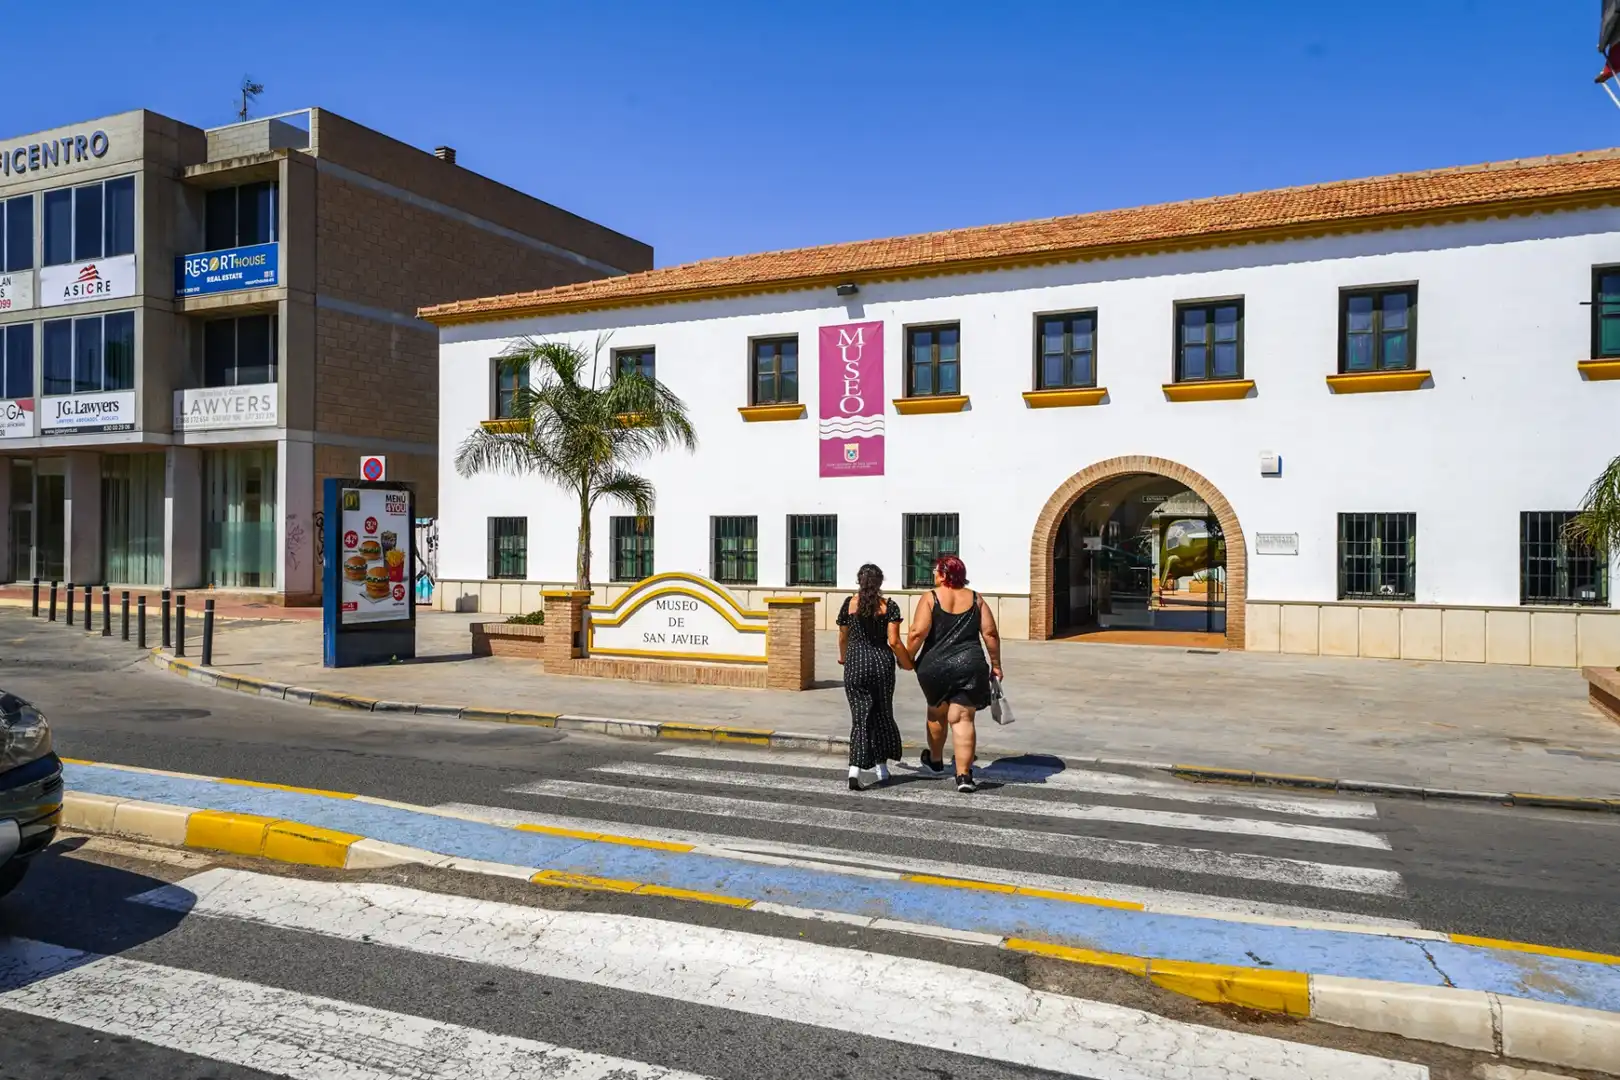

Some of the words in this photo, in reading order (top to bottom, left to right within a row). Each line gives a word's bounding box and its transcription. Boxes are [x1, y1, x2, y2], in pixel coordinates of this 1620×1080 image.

[207, 275, 221, 283] REAL
[222, 272, 243, 280] ESTATE
[63, 280, 111, 298] ASICRE
[836, 327, 866, 414] MUSEO
[180, 395, 271, 415] LAWYERS
[386, 503, 406, 512] 4YOU
[656, 600, 698, 611] MUSEO
[668, 617, 685, 627] DE
[643, 632, 666, 643] SAN
[671, 634, 709, 645] JAVIER
